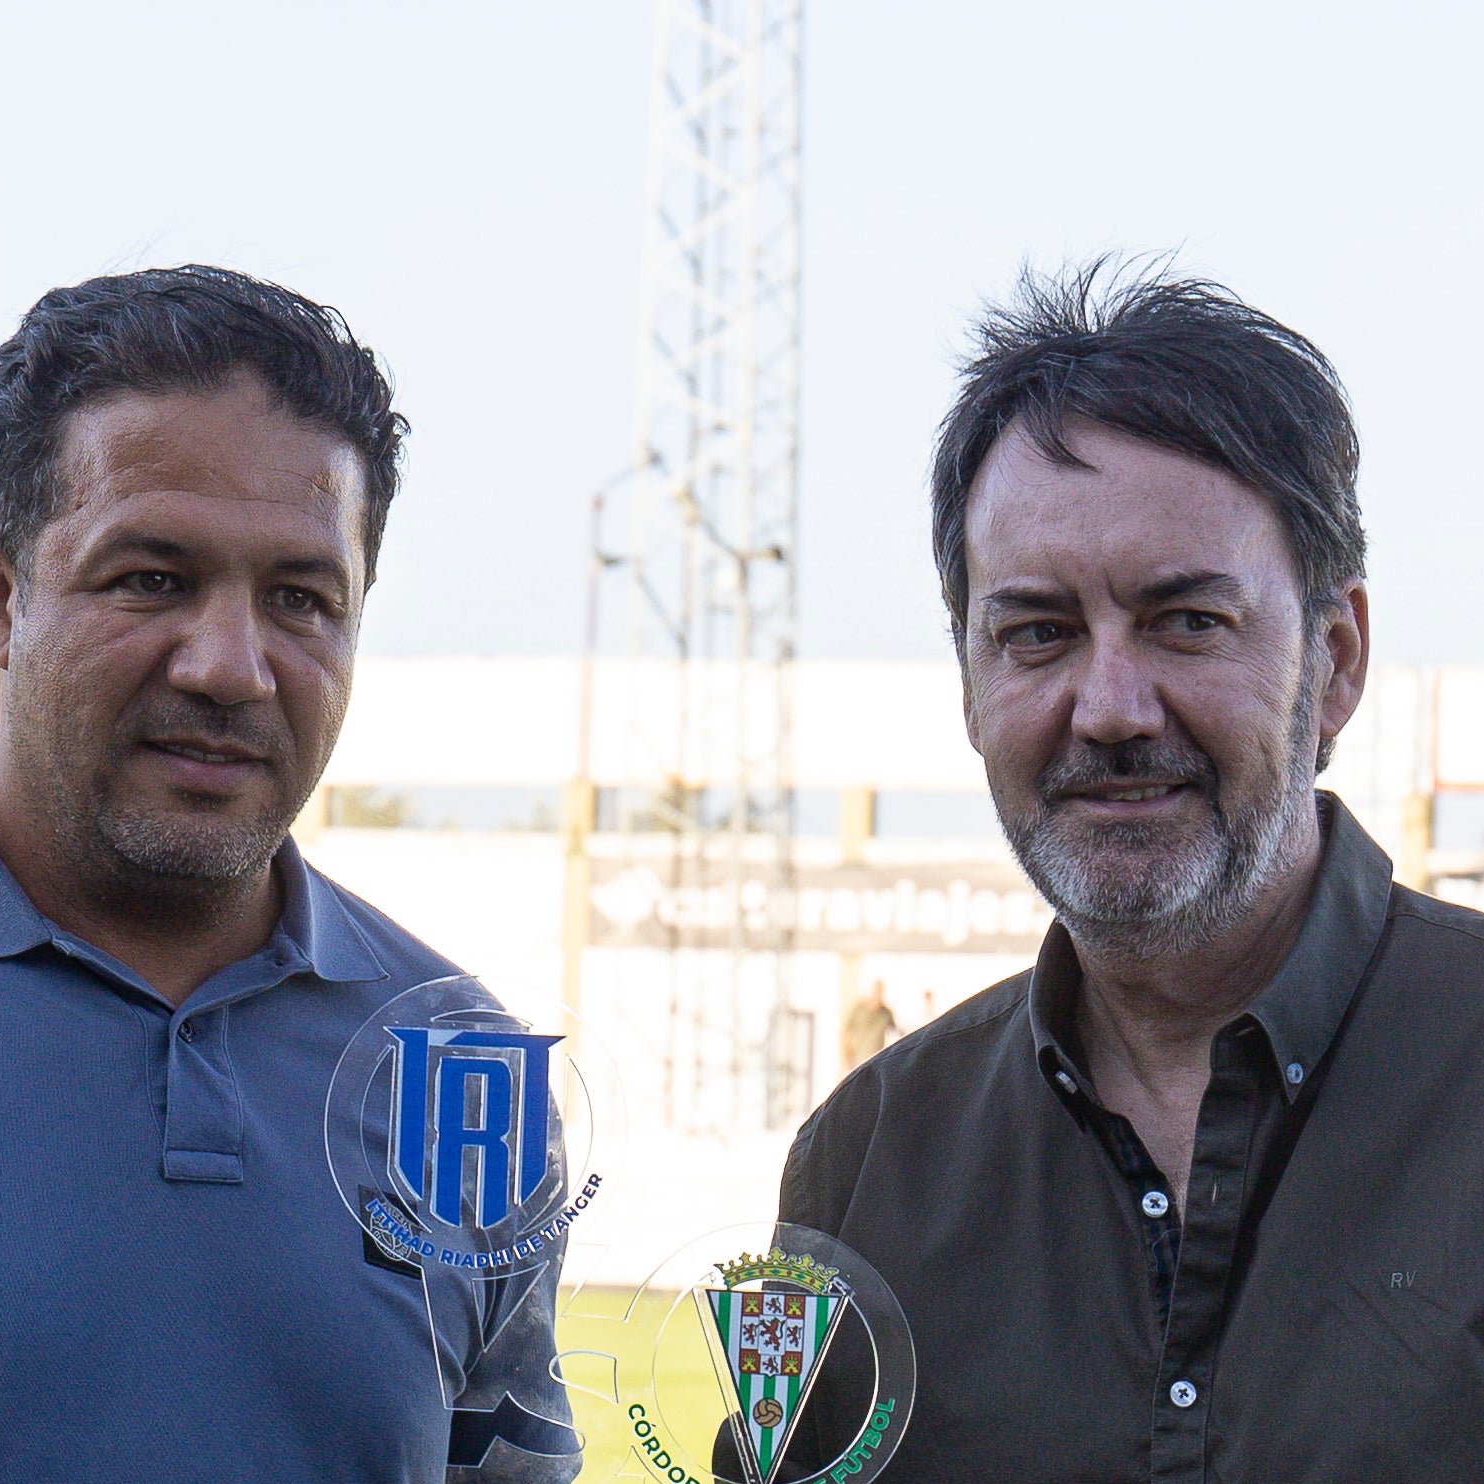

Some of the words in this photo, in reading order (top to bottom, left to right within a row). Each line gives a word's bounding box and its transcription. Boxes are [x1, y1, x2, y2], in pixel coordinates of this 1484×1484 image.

[440, 1248, 513, 1269] RIADHI
[513, 1234, 544, 1260] DE
[541, 1172, 603, 1241] TANGER
